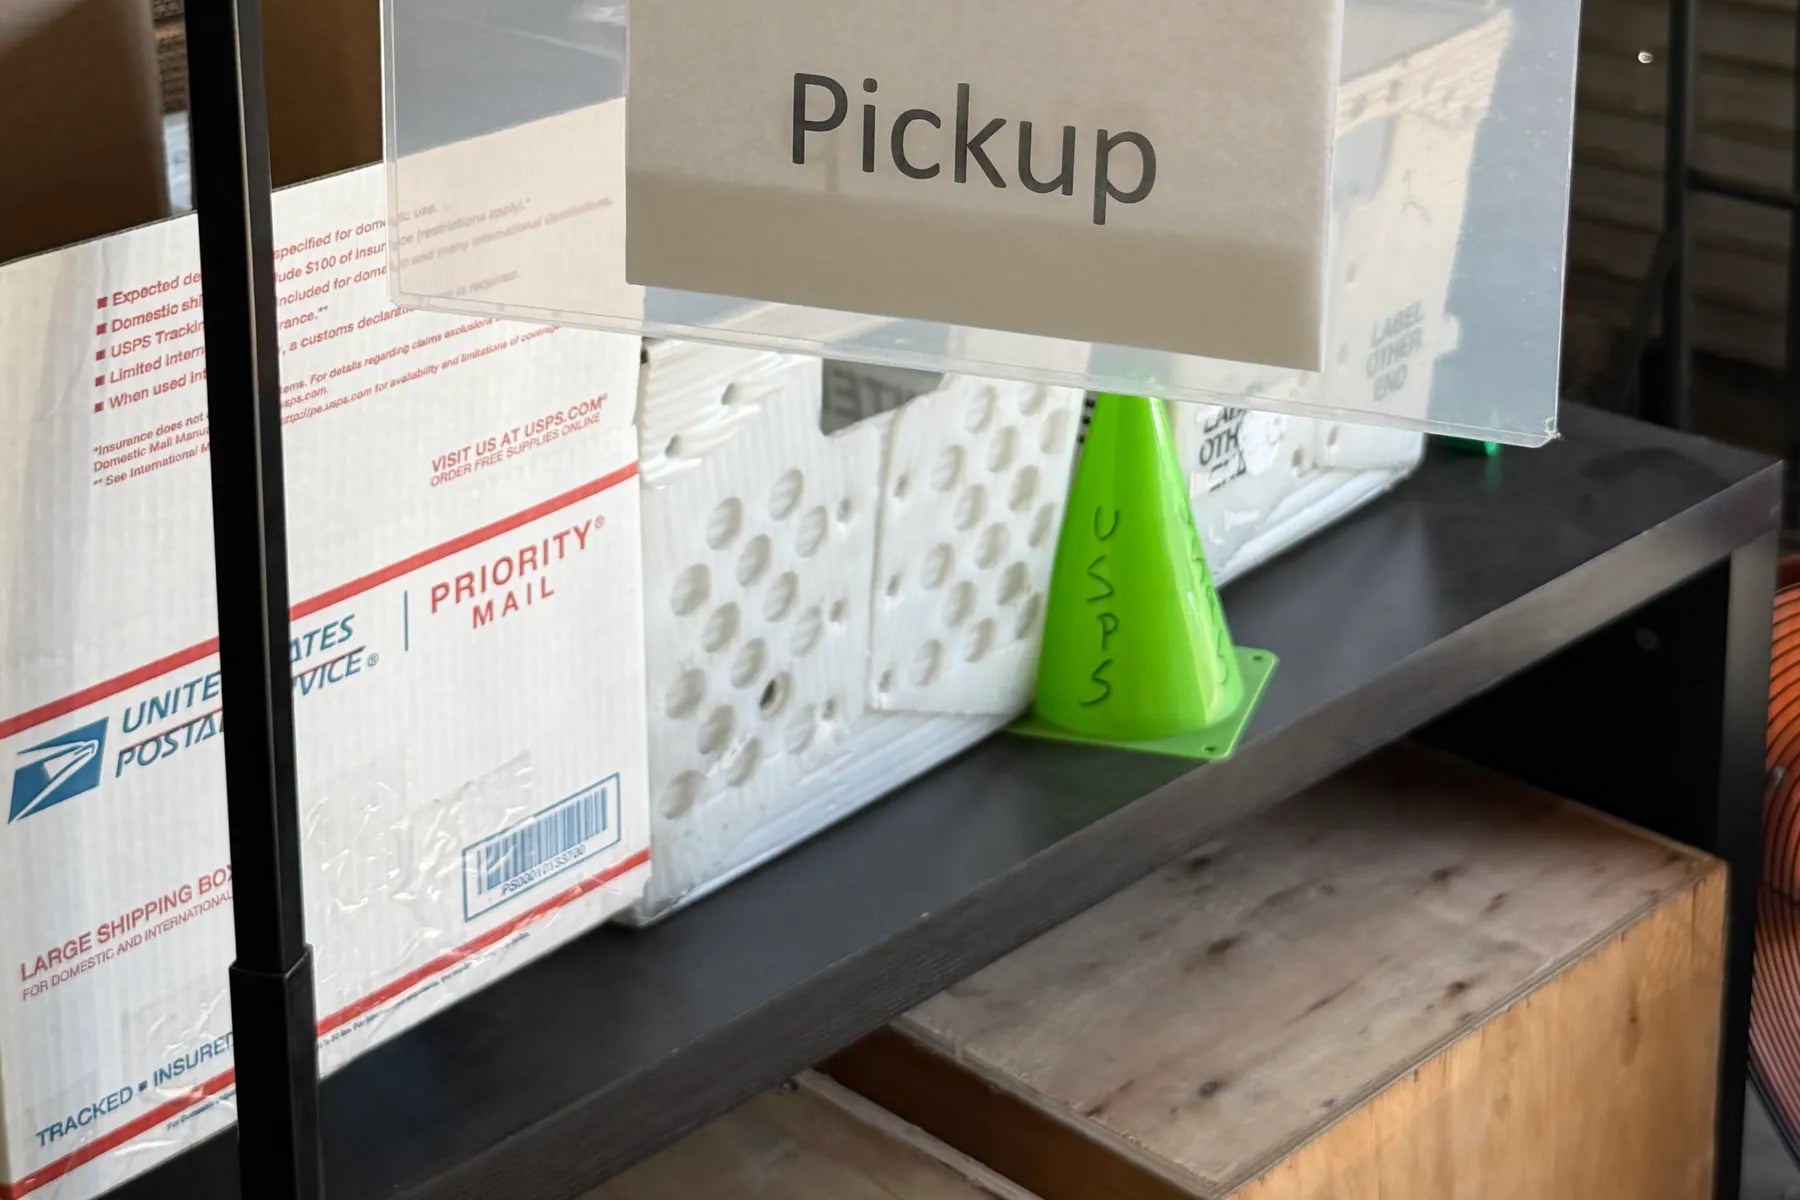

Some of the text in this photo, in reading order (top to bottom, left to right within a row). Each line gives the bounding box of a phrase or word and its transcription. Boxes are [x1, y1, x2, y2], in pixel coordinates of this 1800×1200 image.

[792, 72, 1157, 226] Pickup
[335, 229, 353, 241] for
[306, 255, 336, 275] $100
[340, 250, 353, 264] of
[112, 276, 180, 306] Expected
[279, 280, 330, 307] ncluded
[333, 277, 352, 290] for
[111, 303, 178, 333] Domestic
[300, 322, 354, 348] customs
[1370, 298, 1425, 348] LABEL
[111, 335, 152, 358] USPS
[310, 371, 328, 384] For
[329, 359, 363, 378] details
[364, 344, 410, 367] regarding
[411, 333, 442, 350] claims
[1365, 326, 1421, 379] OTHER
[110, 355, 162, 384] Limited
[374, 381, 389, 393] for
[390, 363, 440, 388] availability
[441, 356, 460, 370] and
[109, 388, 149, 409] When
[153, 373, 187, 396] used
[156, 420, 183, 437] does
[185, 412, 204, 427] not
[94, 447, 147, 472] Domestic
[149, 436, 173, 453] Mail
[105, 472, 128, 486] See
[130, 446, 198, 478] International
[430, 412, 601, 487] ORDER FREE SUPPLIES ONLINE
[431, 445, 472, 473] VISIT
[475, 437, 498, 457] US
[500, 427, 521, 448] AT
[472, 575, 555, 630] MAIL
[1080, 505, 1120, 707] USPS
[122, 613, 356, 734] UNITE ATES
[20, 931, 92, 981] LARGE
[97, 884, 193, 944] SHIPPING
[22, 890, 233, 1001] FOR DOMESTIC AND INTERNATIONAL
[36, 1085, 134, 1148] TRACKED
